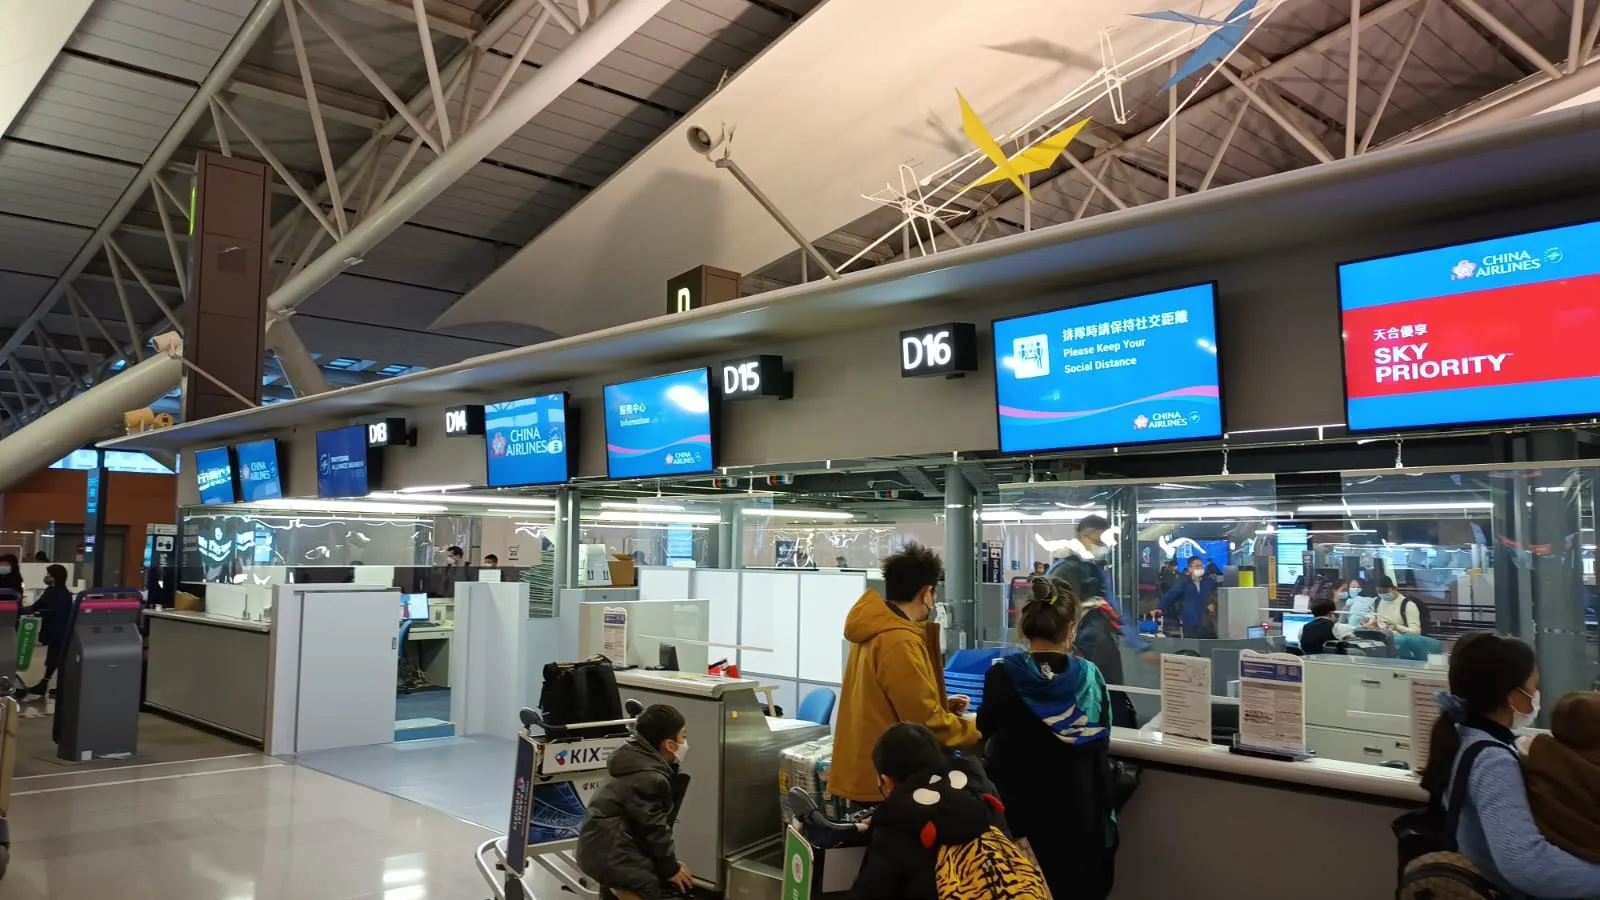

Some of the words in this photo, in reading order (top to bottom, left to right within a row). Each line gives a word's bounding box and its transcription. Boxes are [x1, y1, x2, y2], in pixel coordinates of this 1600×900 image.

[1482, 250, 1531, 266] CHINA
[1476, 258, 1541, 278] AIRLINES
[1373, 323, 1428, 341] 天合優享
[902, 331, 951, 370] D16
[1063, 347, 1094, 357] Please
[1096, 342, 1121, 353] Keep
[1123, 338, 1146, 349] Your
[1374, 342, 1429, 365] SKY
[1064, 361, 1093, 374] Social
[1095, 357, 1137, 370] Distance
[1375, 353, 1507, 383] PRIORITY
[724, 362, 760, 394] D15
[1148, 418, 1188, 429] AIRLINES
[1152, 411, 1181, 421] CHINA
[510, 427, 541, 442] CHINA
[506, 440, 548, 456] AIRLINES
[251, 462, 267, 472] CHINA
[673, 457, 695, 465] AIRLINES
[570, 747, 600, 764] KIX
